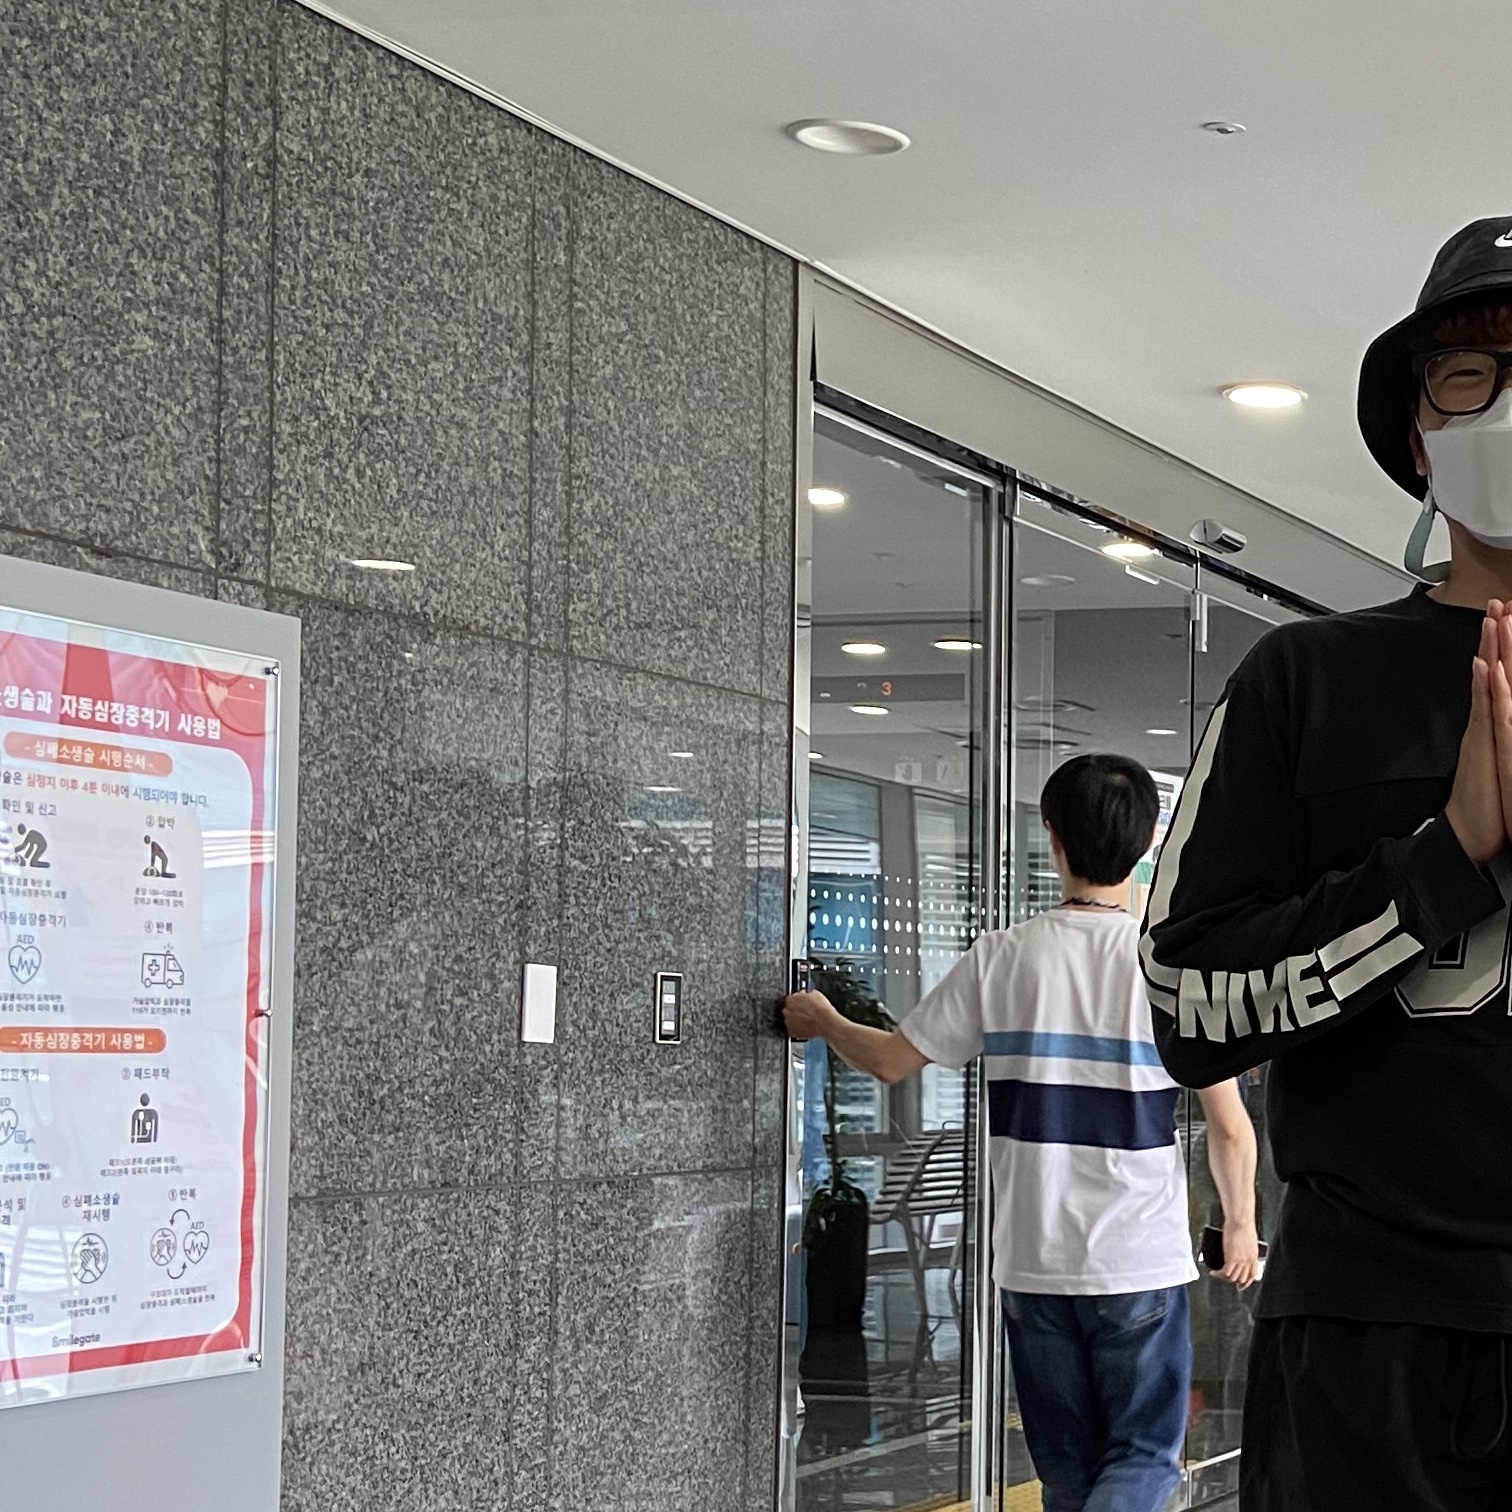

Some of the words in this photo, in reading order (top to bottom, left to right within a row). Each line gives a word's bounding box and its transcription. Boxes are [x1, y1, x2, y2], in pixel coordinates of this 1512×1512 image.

[0, 685, 52, 714] 생술과
[177, 713, 221, 740] 사용법
[0, 770, 22, 786] 술은
[16, 934, 35, 945] AED
[1179, 948, 1341, 1044] NIKE
[20, 1031, 106, 1050] 자동심장충격기
[110, 1033, 145, 1050] 사용법
[52, 1333, 101, 1348] Smilegate
